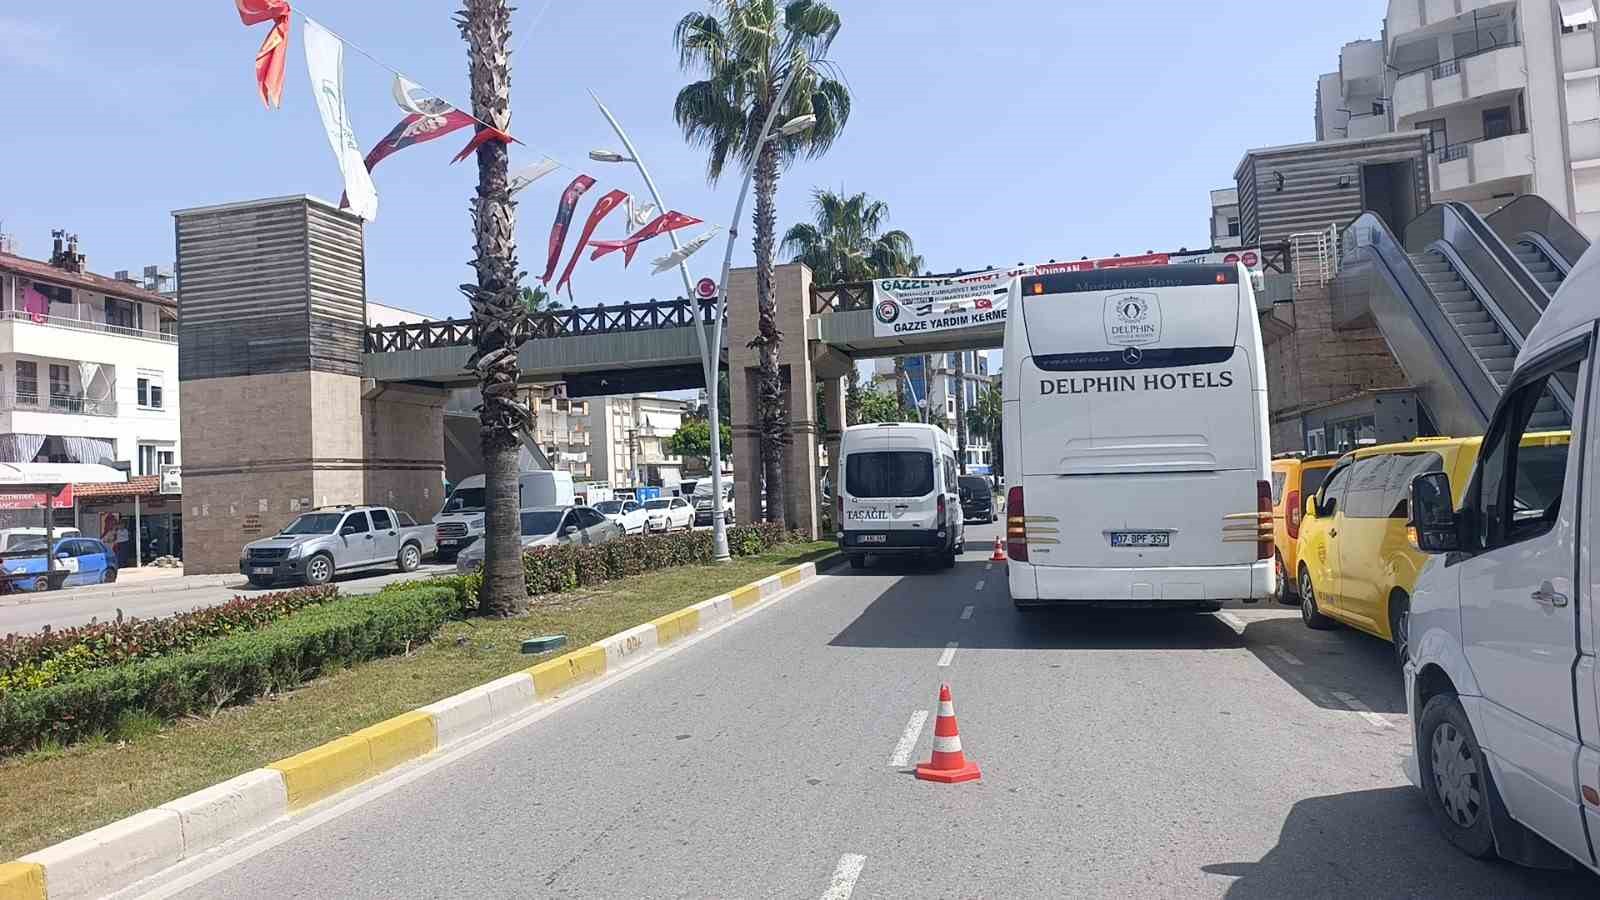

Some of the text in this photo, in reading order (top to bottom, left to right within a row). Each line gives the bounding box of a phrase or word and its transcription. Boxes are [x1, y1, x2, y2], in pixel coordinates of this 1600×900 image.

[894, 309, 1008, 333] GAZZE YARDIM KERME
[1112, 324, 1154, 334] DELPHIN
[1040, 371, 1233, 395] DELPHIN HOTELS
[847, 506, 888, 523] TAŞAĞIL
